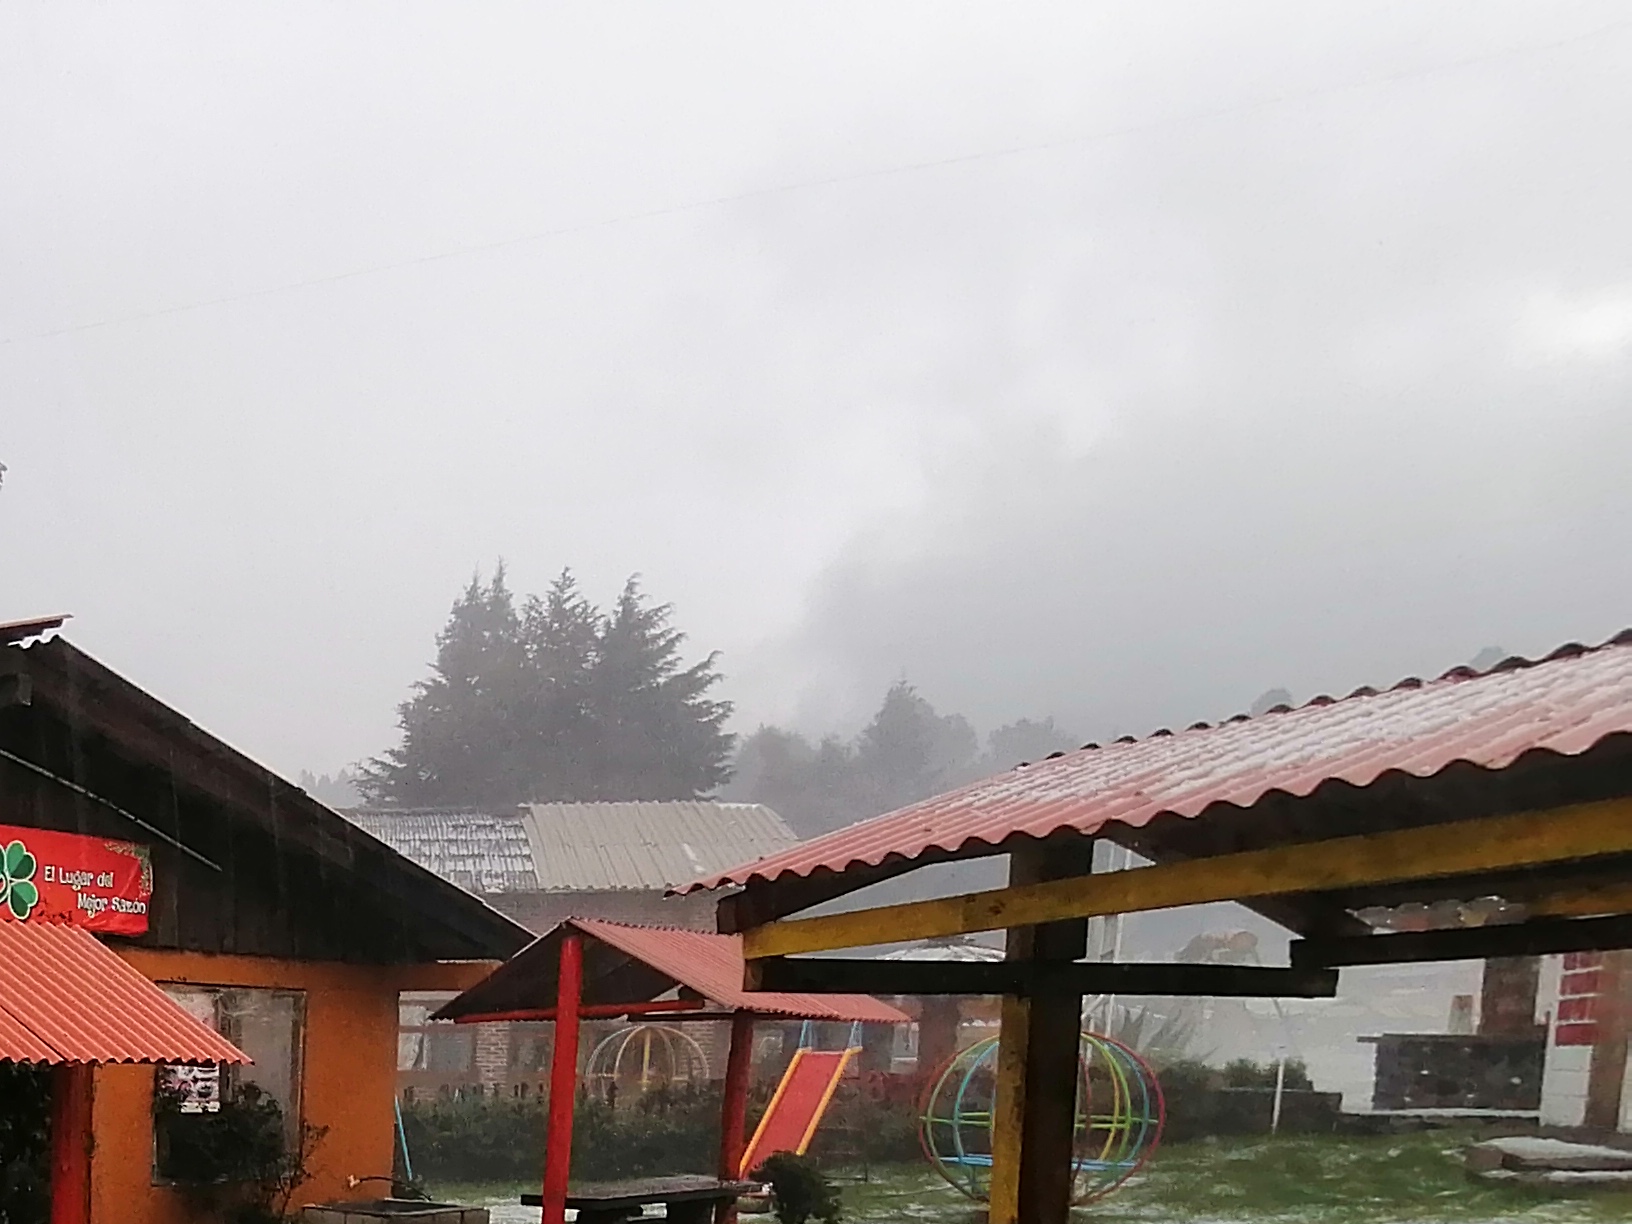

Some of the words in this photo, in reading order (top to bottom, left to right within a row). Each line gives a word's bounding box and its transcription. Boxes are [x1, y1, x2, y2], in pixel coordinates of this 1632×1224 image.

[44, 865, 56, 882] El
[59, 867, 94, 891] Lugar
[96, 871, 114, 888] del
[77, 892, 108, 919] Mejor
[111, 896, 146, 914] Sazón
